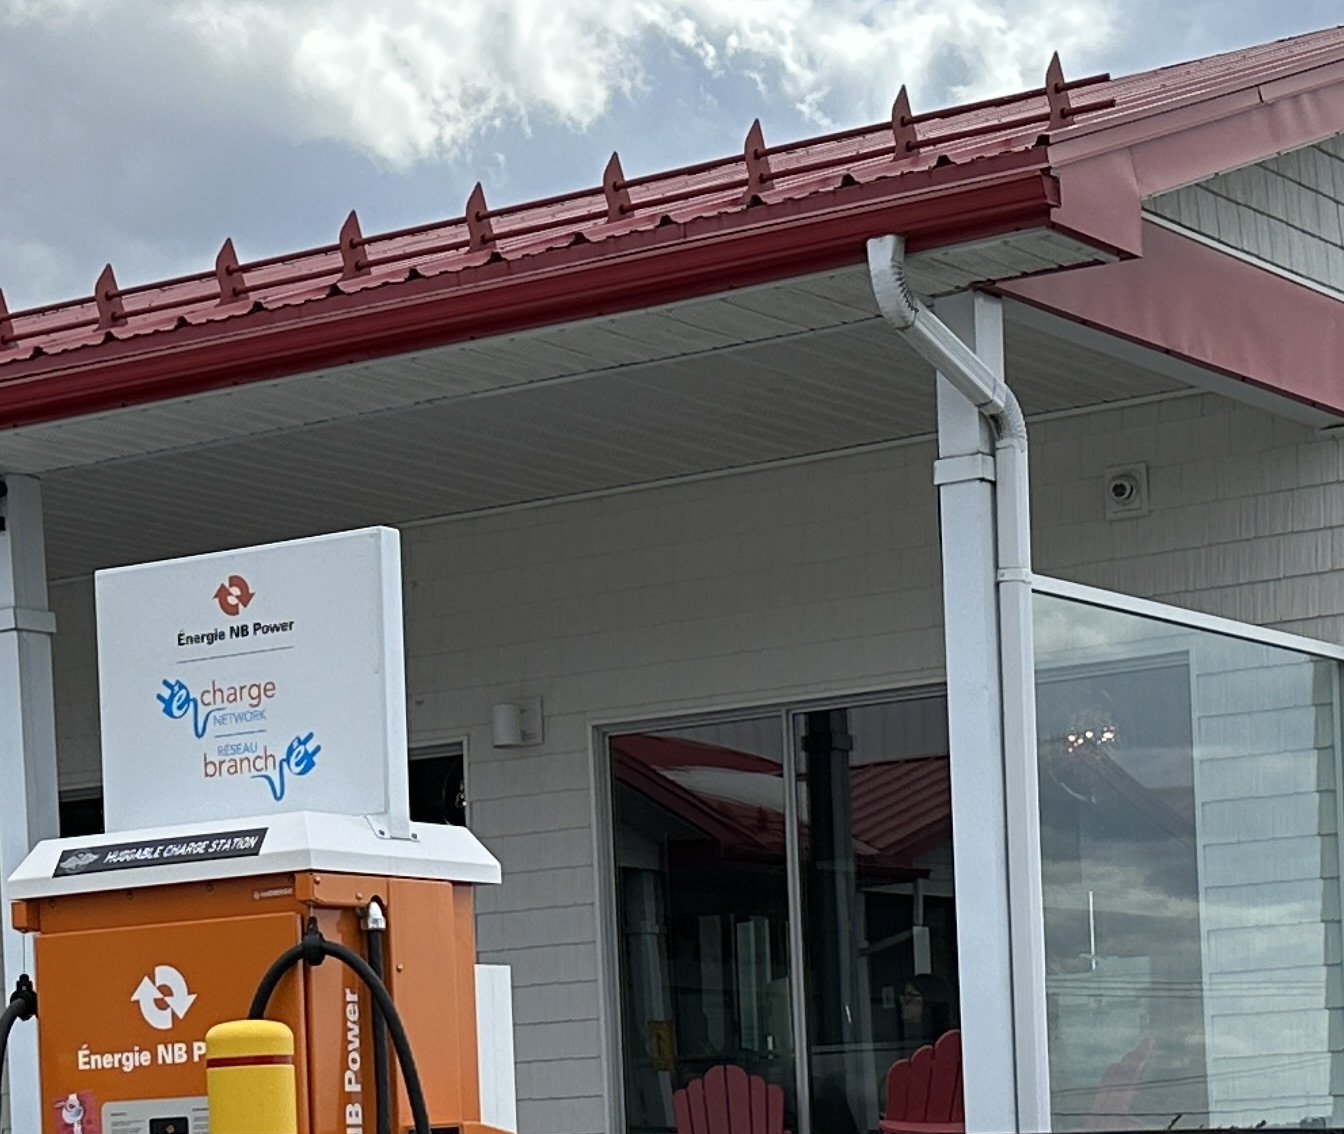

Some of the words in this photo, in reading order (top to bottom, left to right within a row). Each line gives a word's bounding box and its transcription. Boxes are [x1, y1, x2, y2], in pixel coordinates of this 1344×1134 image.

[178, 629, 225, 647] Énergie
[230, 625, 249, 640] NB
[253, 620, 294, 636] Power
[200, 680, 276, 707] charge
[213, 709, 266, 726] NETWORK
[217, 742, 258, 757] RÉSEAU
[103, 847, 160, 864] HUGGABLE
[163, 841, 209, 859] CHARGE
[208, 835, 259, 854] STATION
[344, 988, 362, 1093] Power
[77, 1043, 151, 1073] Énergie
[157, 1044, 187, 1065] NB
